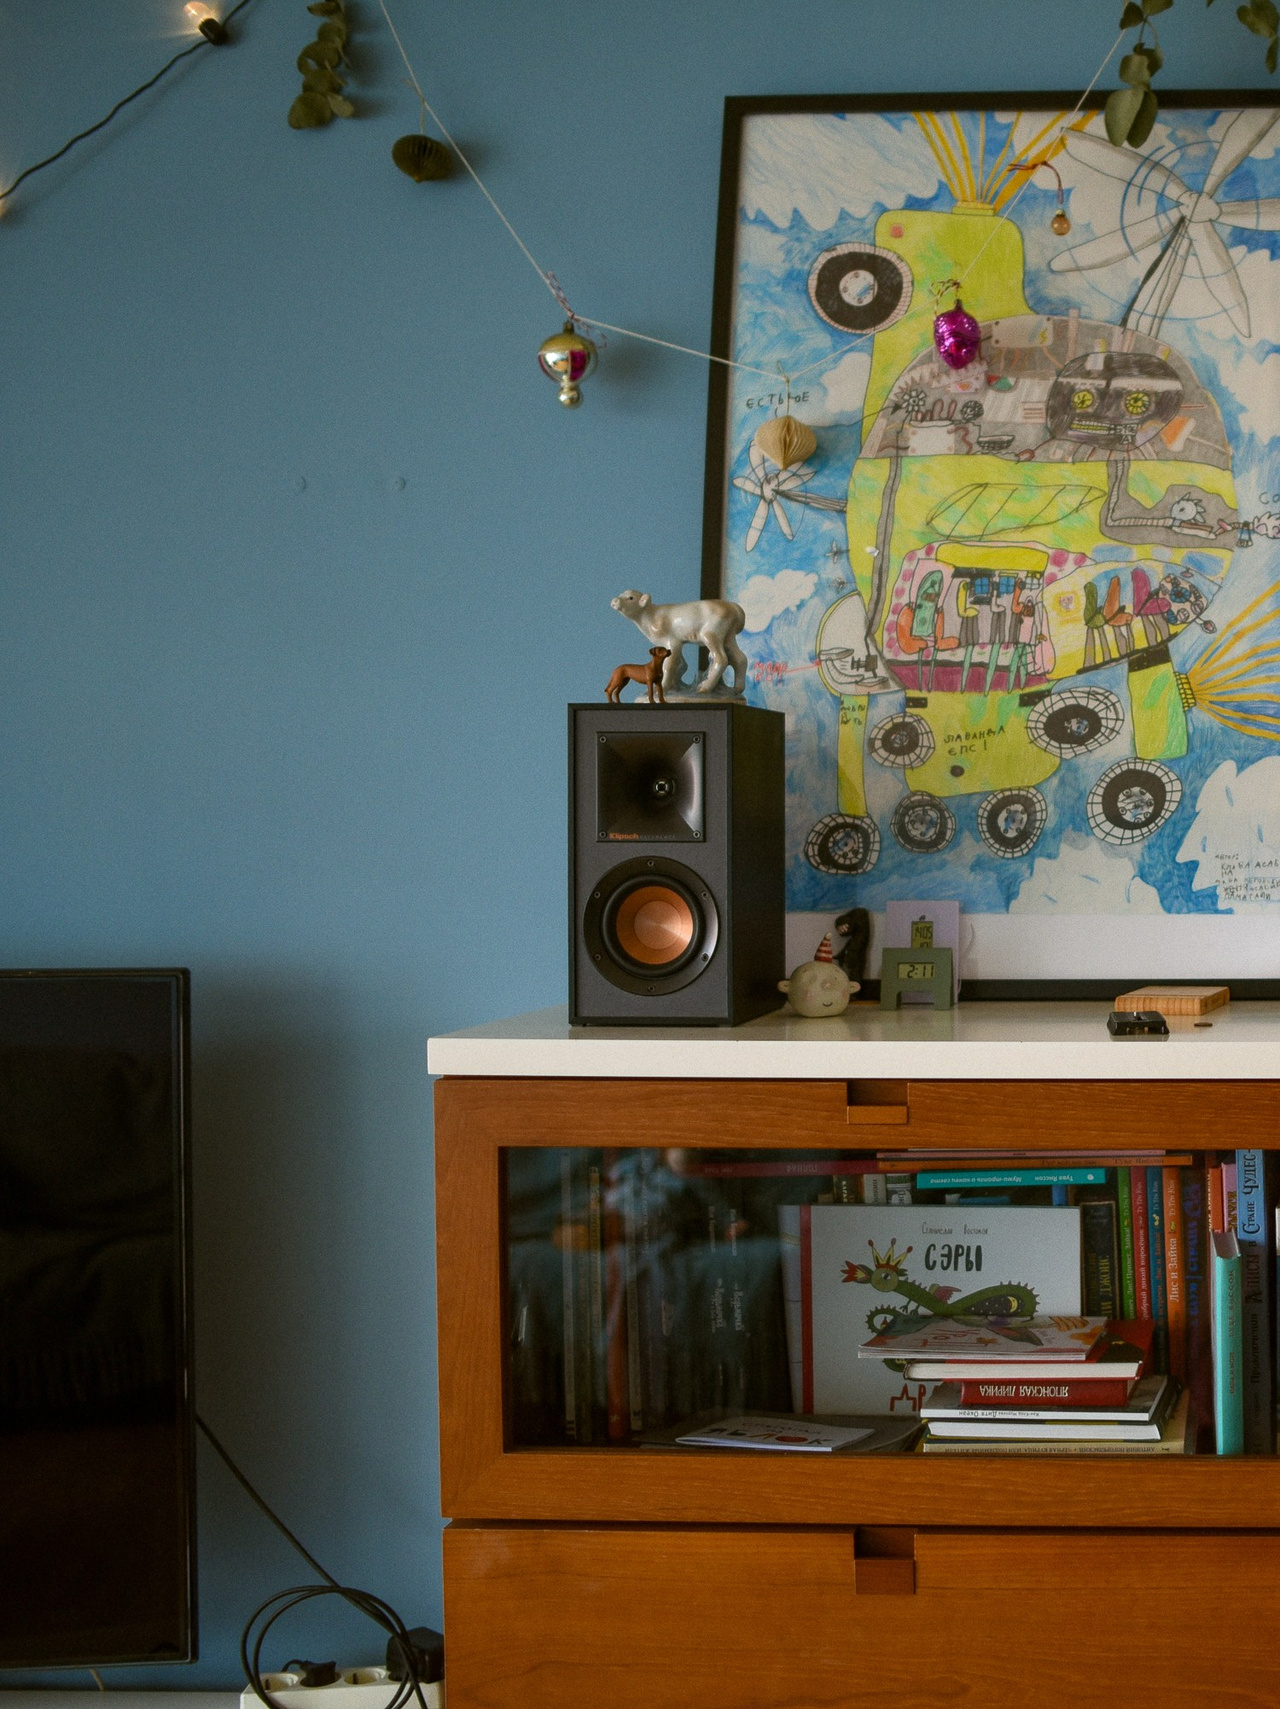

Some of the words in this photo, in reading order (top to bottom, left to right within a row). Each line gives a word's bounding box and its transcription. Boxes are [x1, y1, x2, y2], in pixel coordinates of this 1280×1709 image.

[924, 1243, 983, 1272] СЭРЫ
[1167, 1238, 1178, 1270] Зайка
[1170, 1282, 1179, 1302] Лис
[978, 1385, 1016, 1397] ЛИРИКА
[1019, 1385, 1069, 1397] ЯПОНСКАЯ
